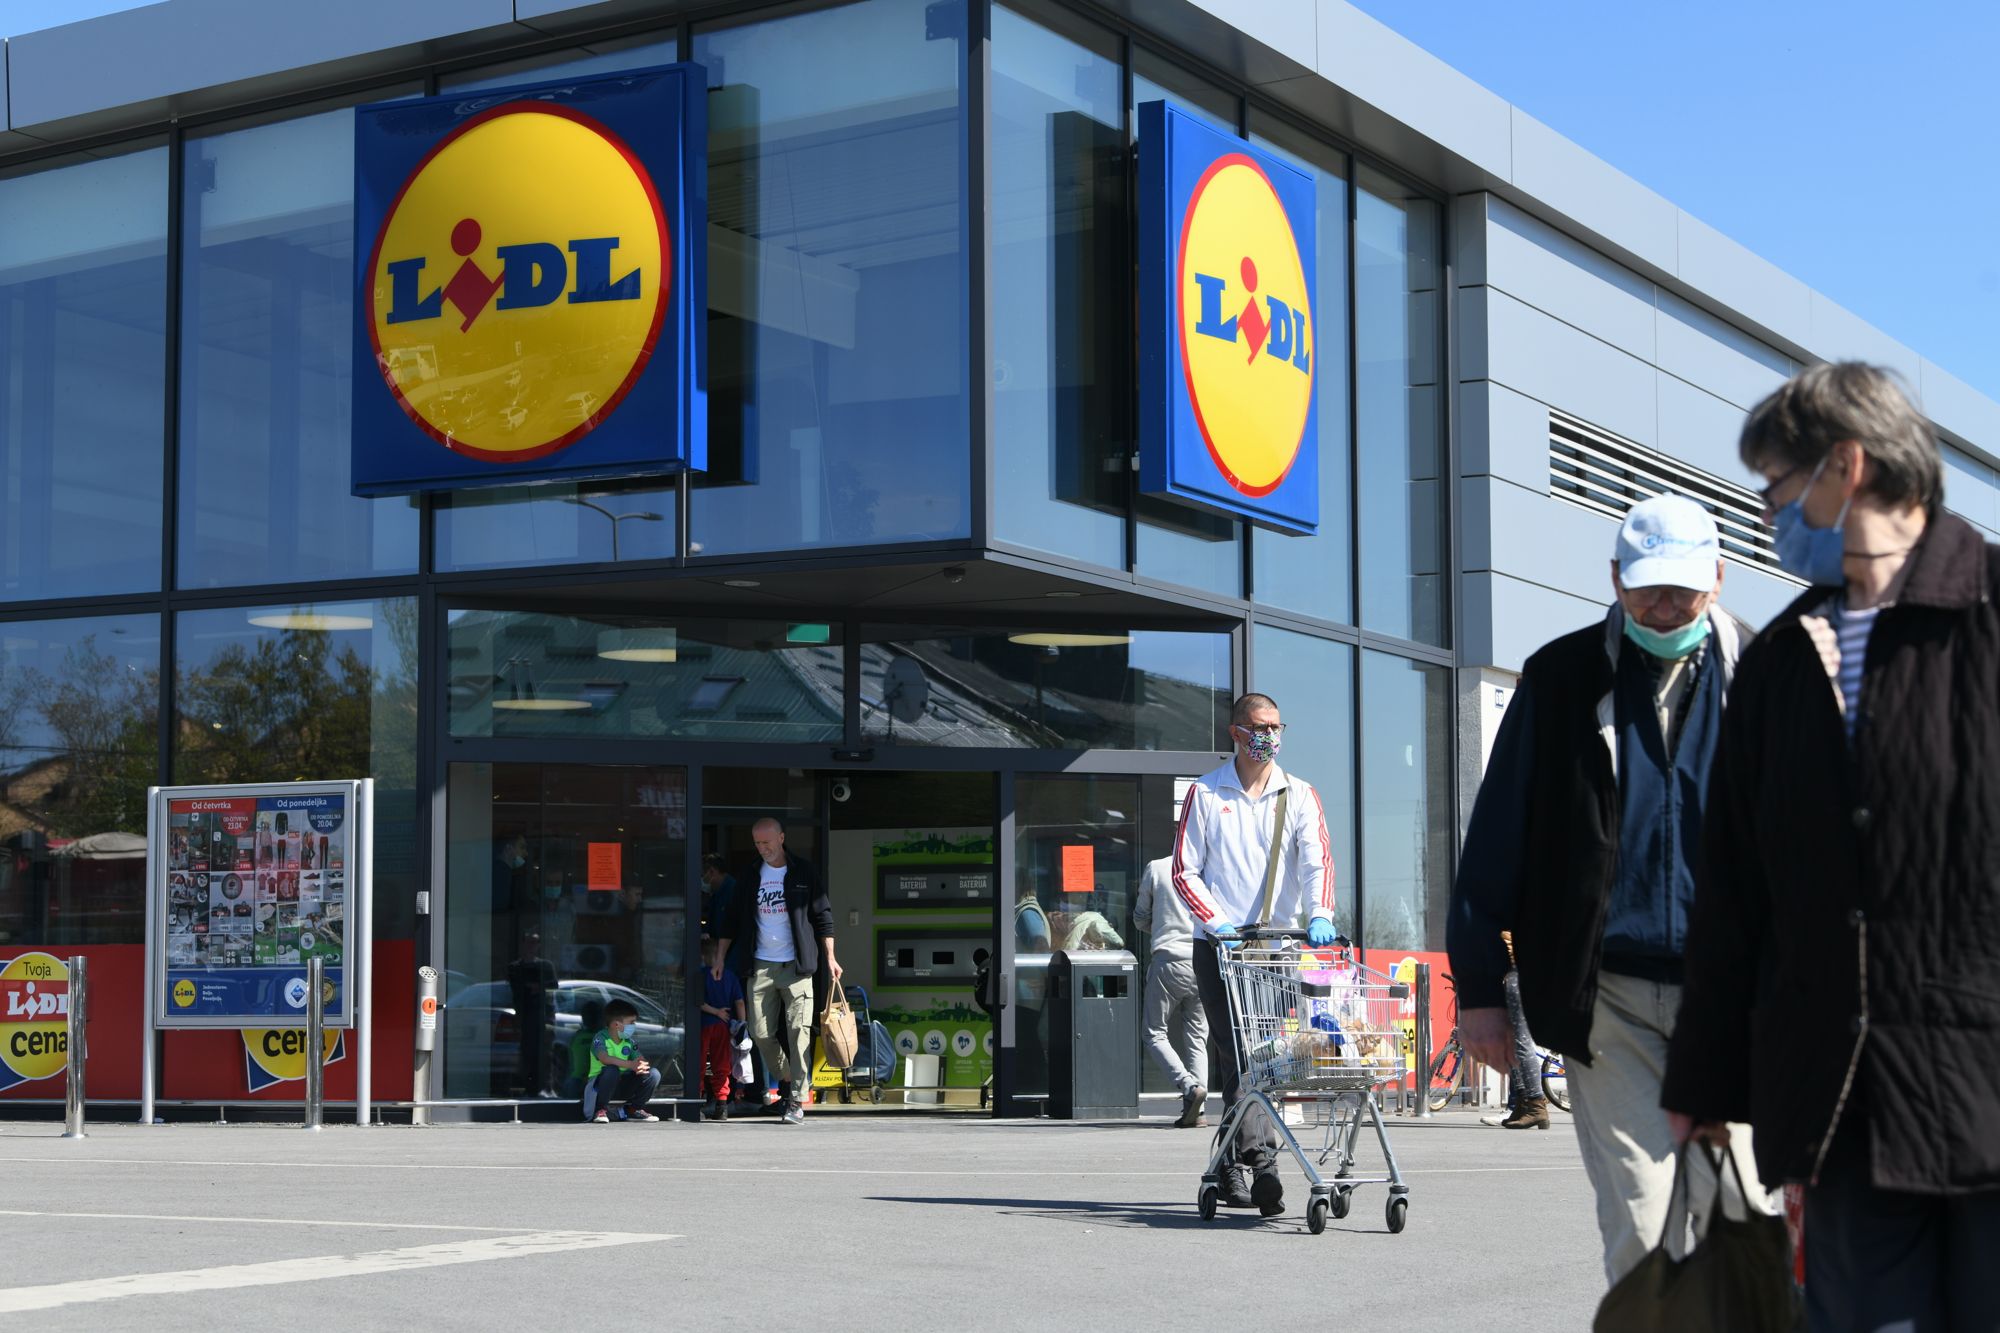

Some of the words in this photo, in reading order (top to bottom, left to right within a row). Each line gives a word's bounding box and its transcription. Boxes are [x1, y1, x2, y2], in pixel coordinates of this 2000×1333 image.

[191, 801, 202, 810] Od
[277, 799, 288, 808] Od
[289, 797, 328, 808] ponedeljka
[757, 888, 784, 906] Espr
[23, 961, 52, 980] Tvoja
[10, 1030, 68, 1058] cena
